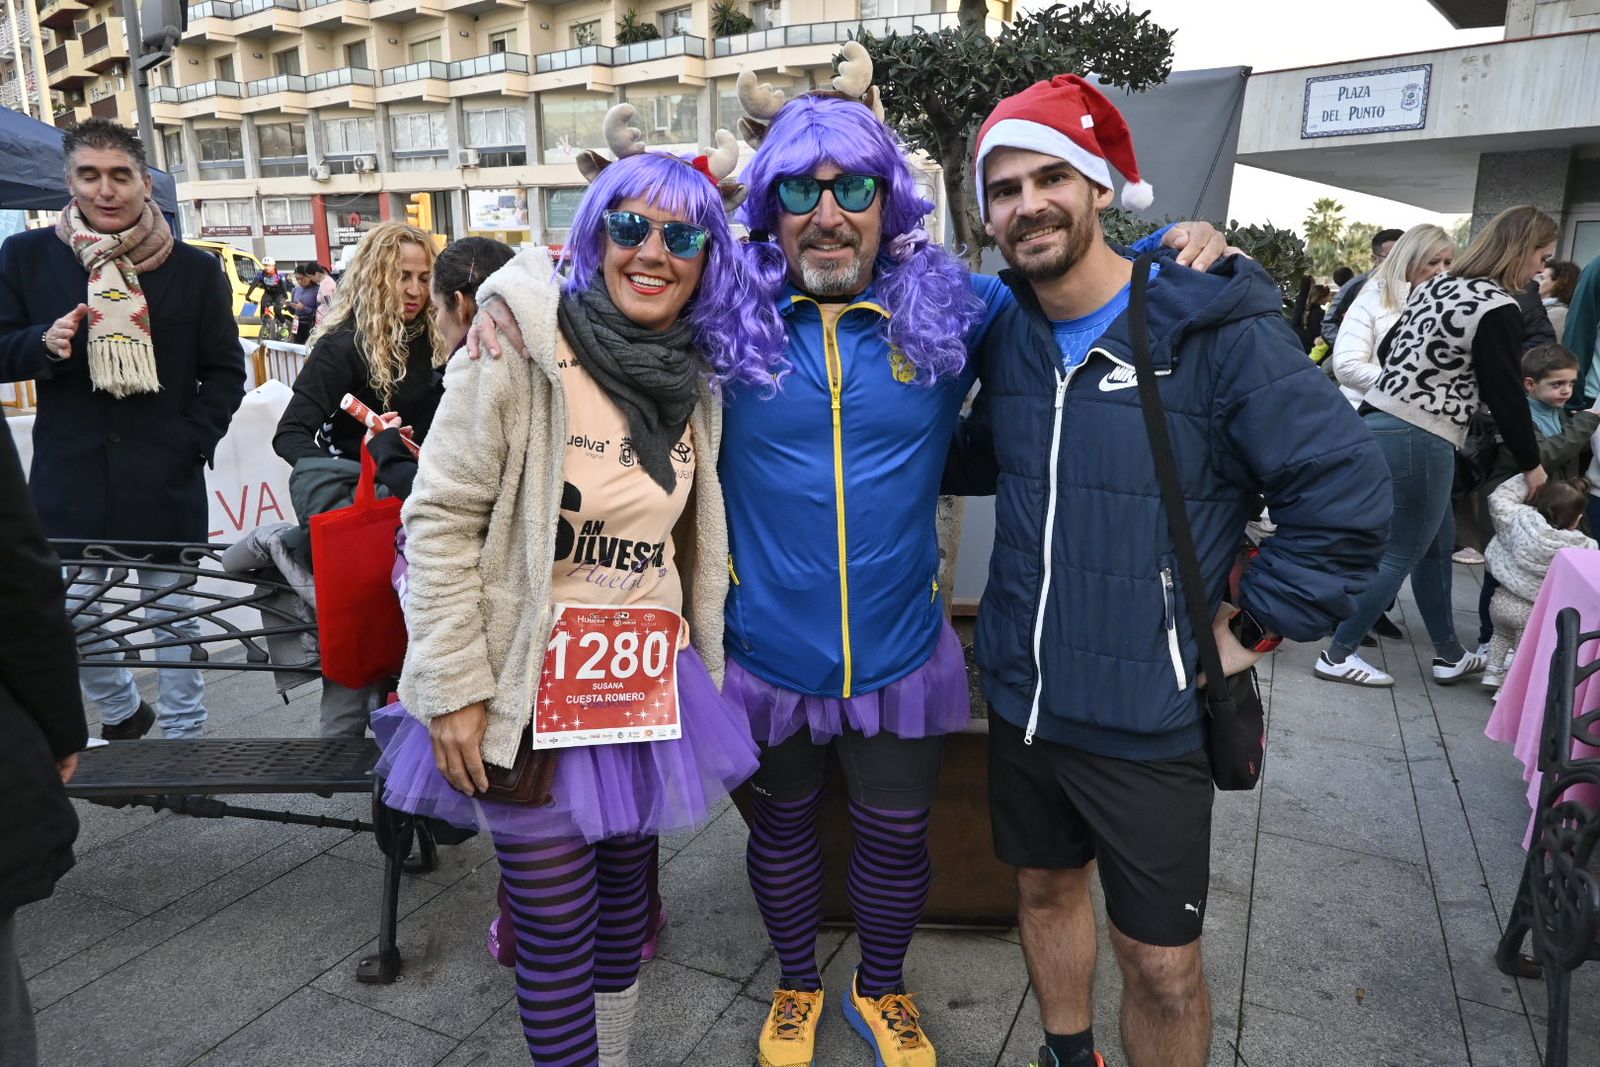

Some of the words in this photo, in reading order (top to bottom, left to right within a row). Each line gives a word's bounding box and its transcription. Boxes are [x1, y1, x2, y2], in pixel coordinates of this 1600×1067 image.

[1338, 86, 1371, 101] PLAZA
[1322, 109, 1341, 122] DEL
[1348, 105, 1386, 121] PUNTO
[547, 631, 668, 680] 1280
[592, 682, 624, 690] SUSANA
[566, 693, 603, 704] CUESTA
[606, 692, 645, 702] ROMERO
